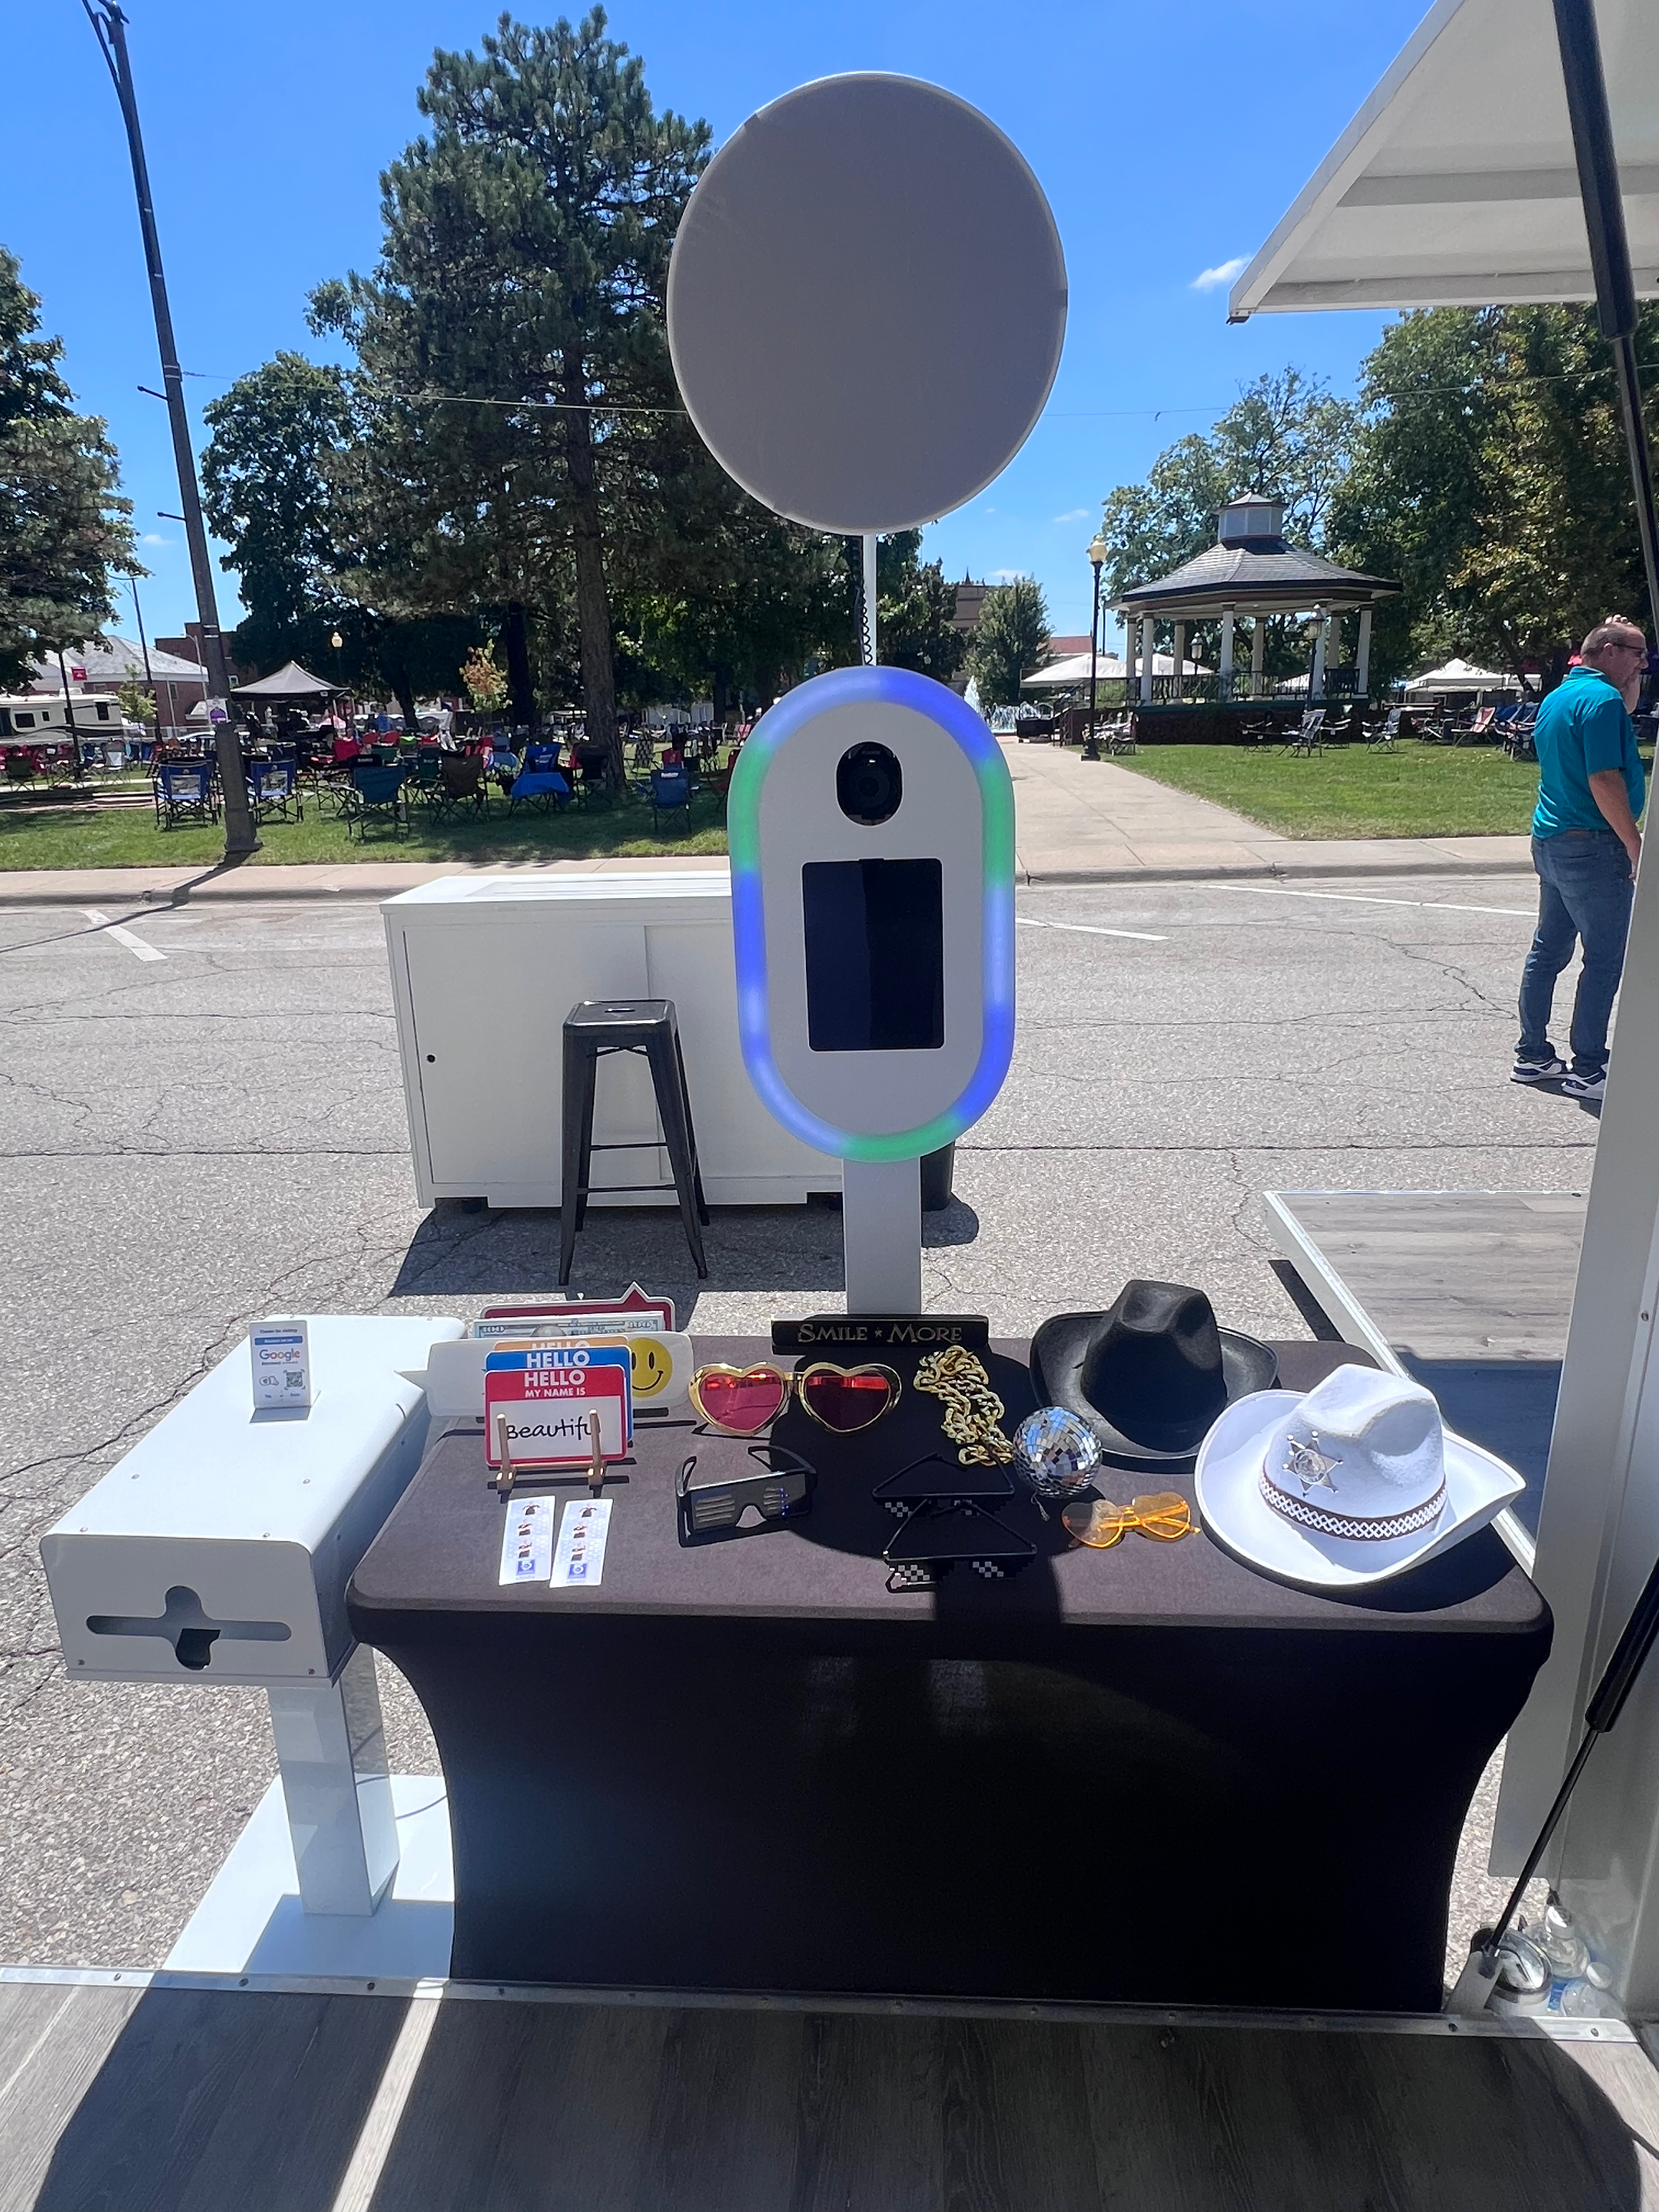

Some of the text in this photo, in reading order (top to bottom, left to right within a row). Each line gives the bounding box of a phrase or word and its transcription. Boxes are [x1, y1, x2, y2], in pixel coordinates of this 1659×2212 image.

[798, 1323, 962, 1344] SMILE MORE
[259, 1348, 301, 1361] Google
[527, 1350, 590, 1368] HELLO
[524, 1369, 585, 1387] HELLO
[525, 1387, 586, 1398] MY NAME IS
[506, 1415, 596, 1441] Beautifu
